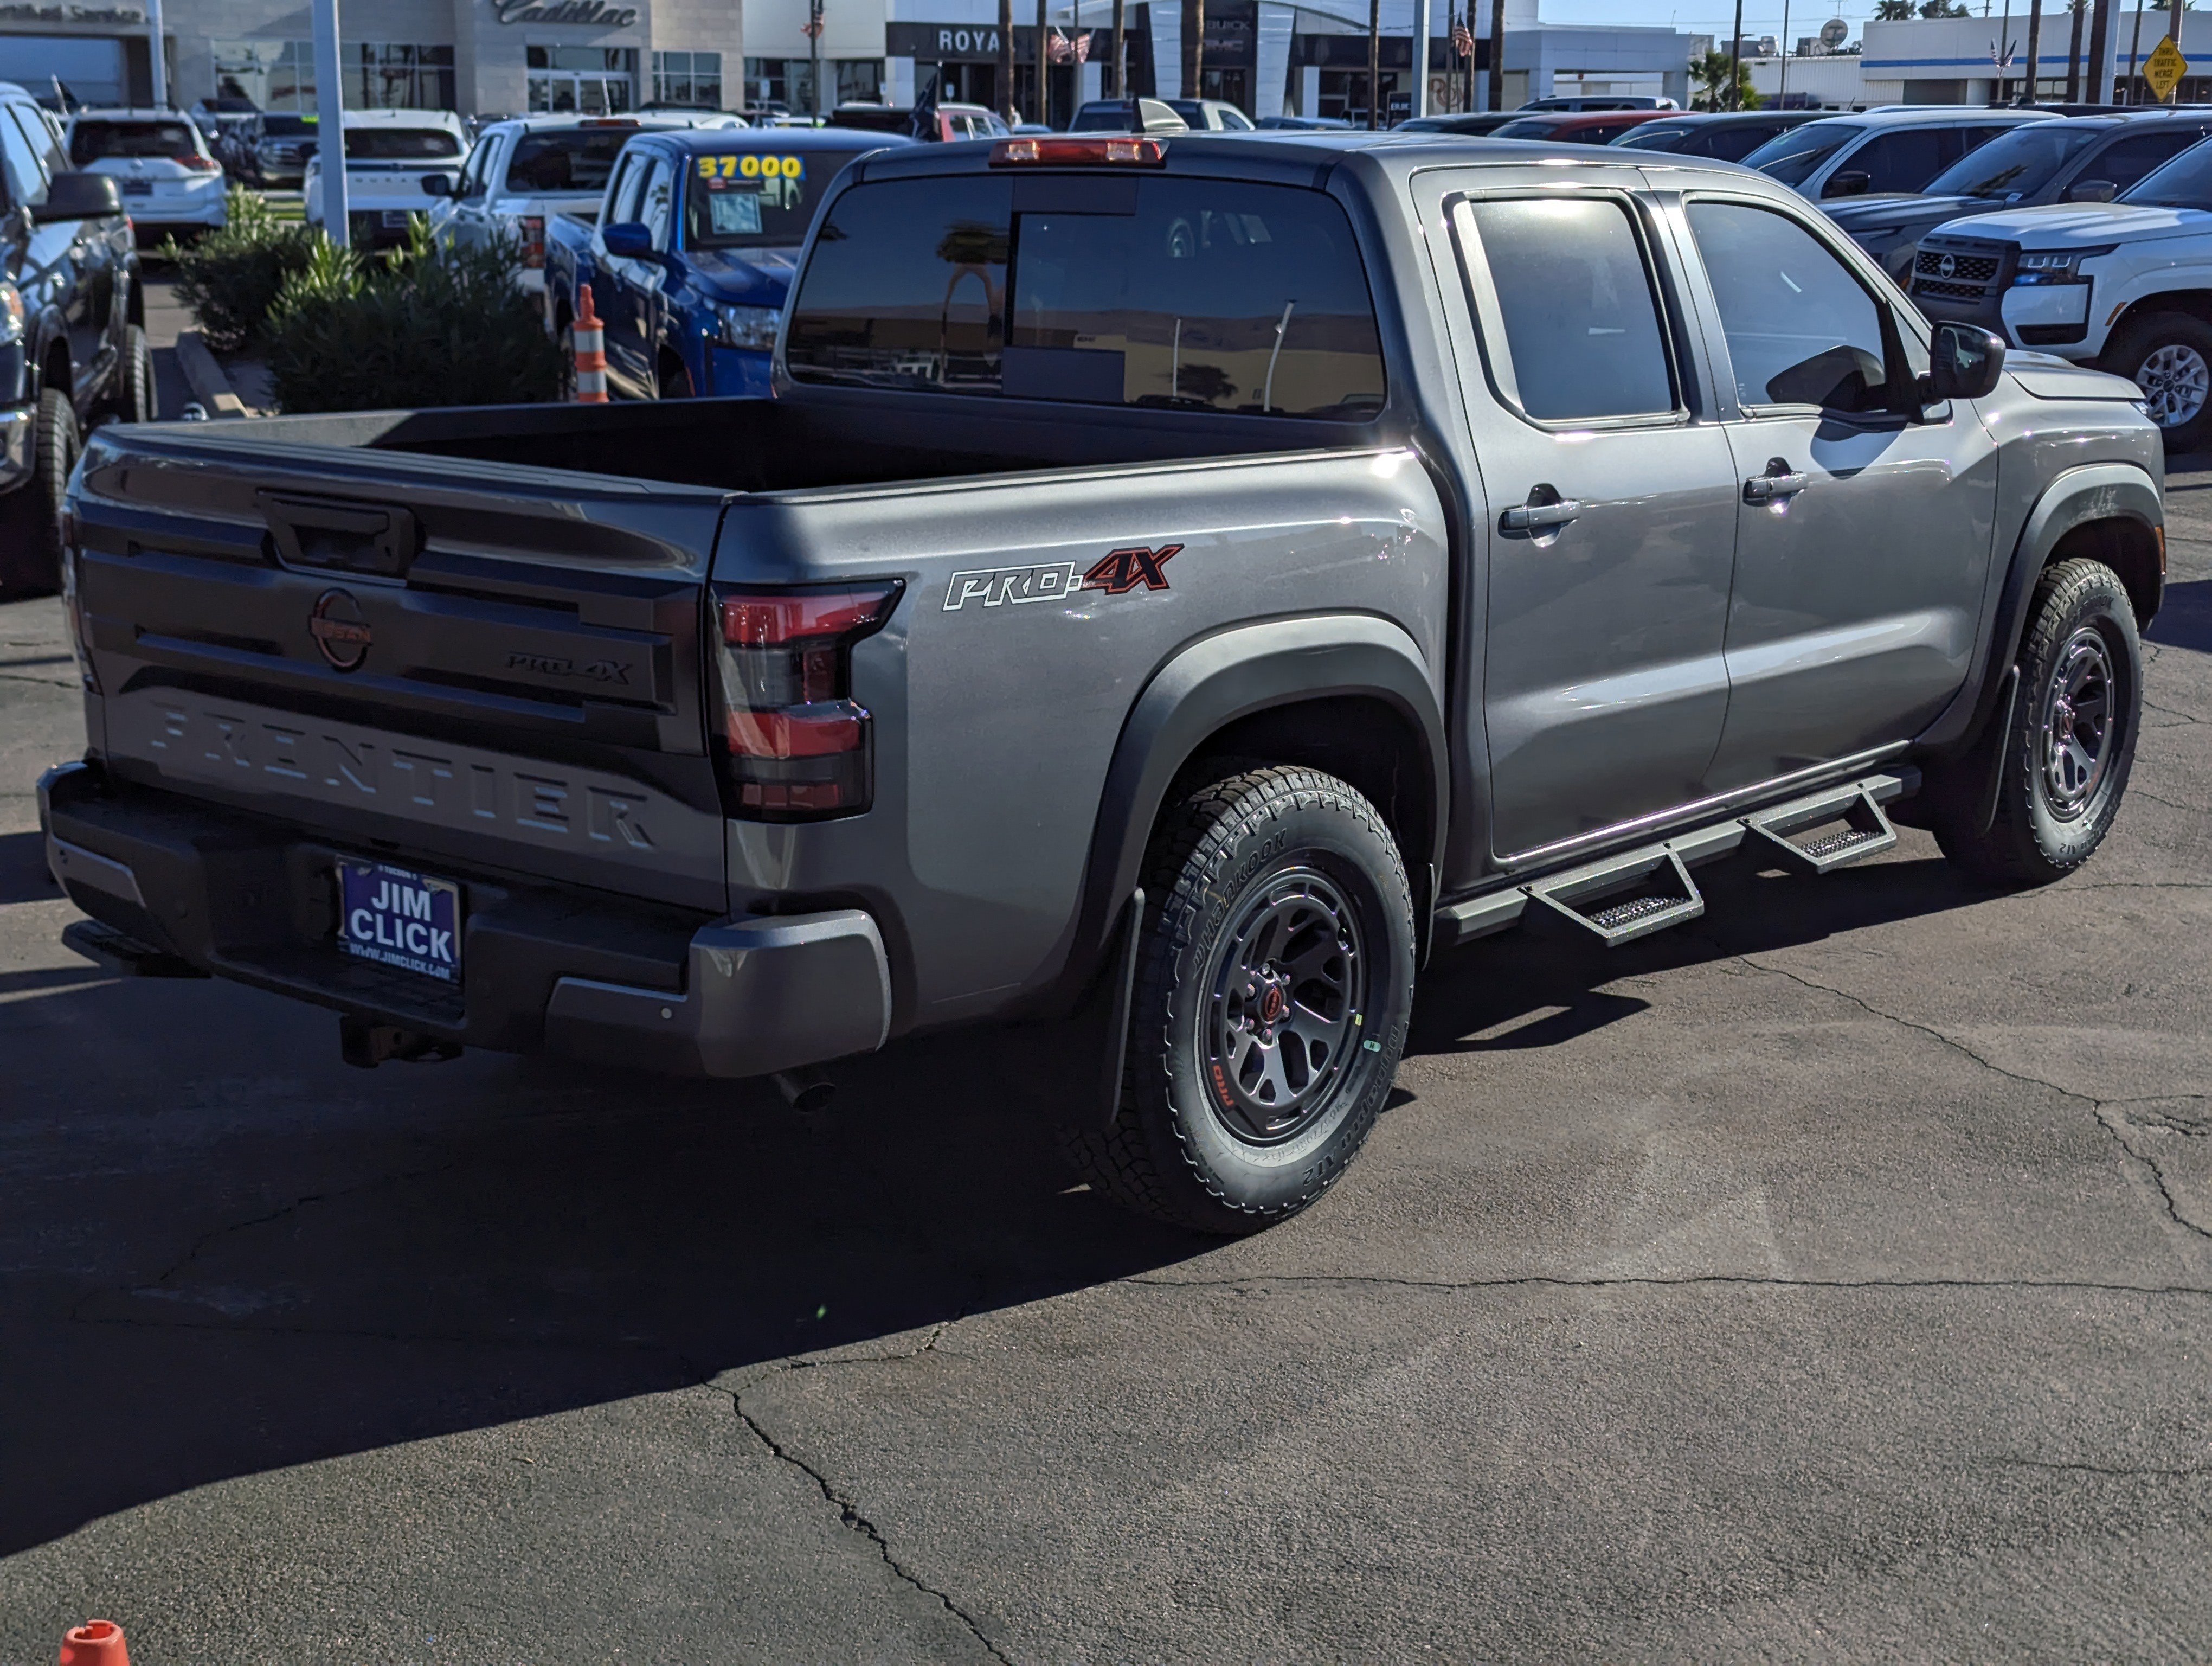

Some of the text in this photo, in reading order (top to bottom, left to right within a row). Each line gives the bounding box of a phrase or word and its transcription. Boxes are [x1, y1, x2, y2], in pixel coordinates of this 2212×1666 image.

[1206, 20, 1250, 29] BUICK
[938, 30, 1016, 53] ROYA
[2156, 81, 2170, 89] LEFT
[698, 156, 801, 178] 37000
[150, 700, 654, 849] FRONTIER
[371, 880, 432, 921] JIM
[351, 908, 452, 963] CLICK
